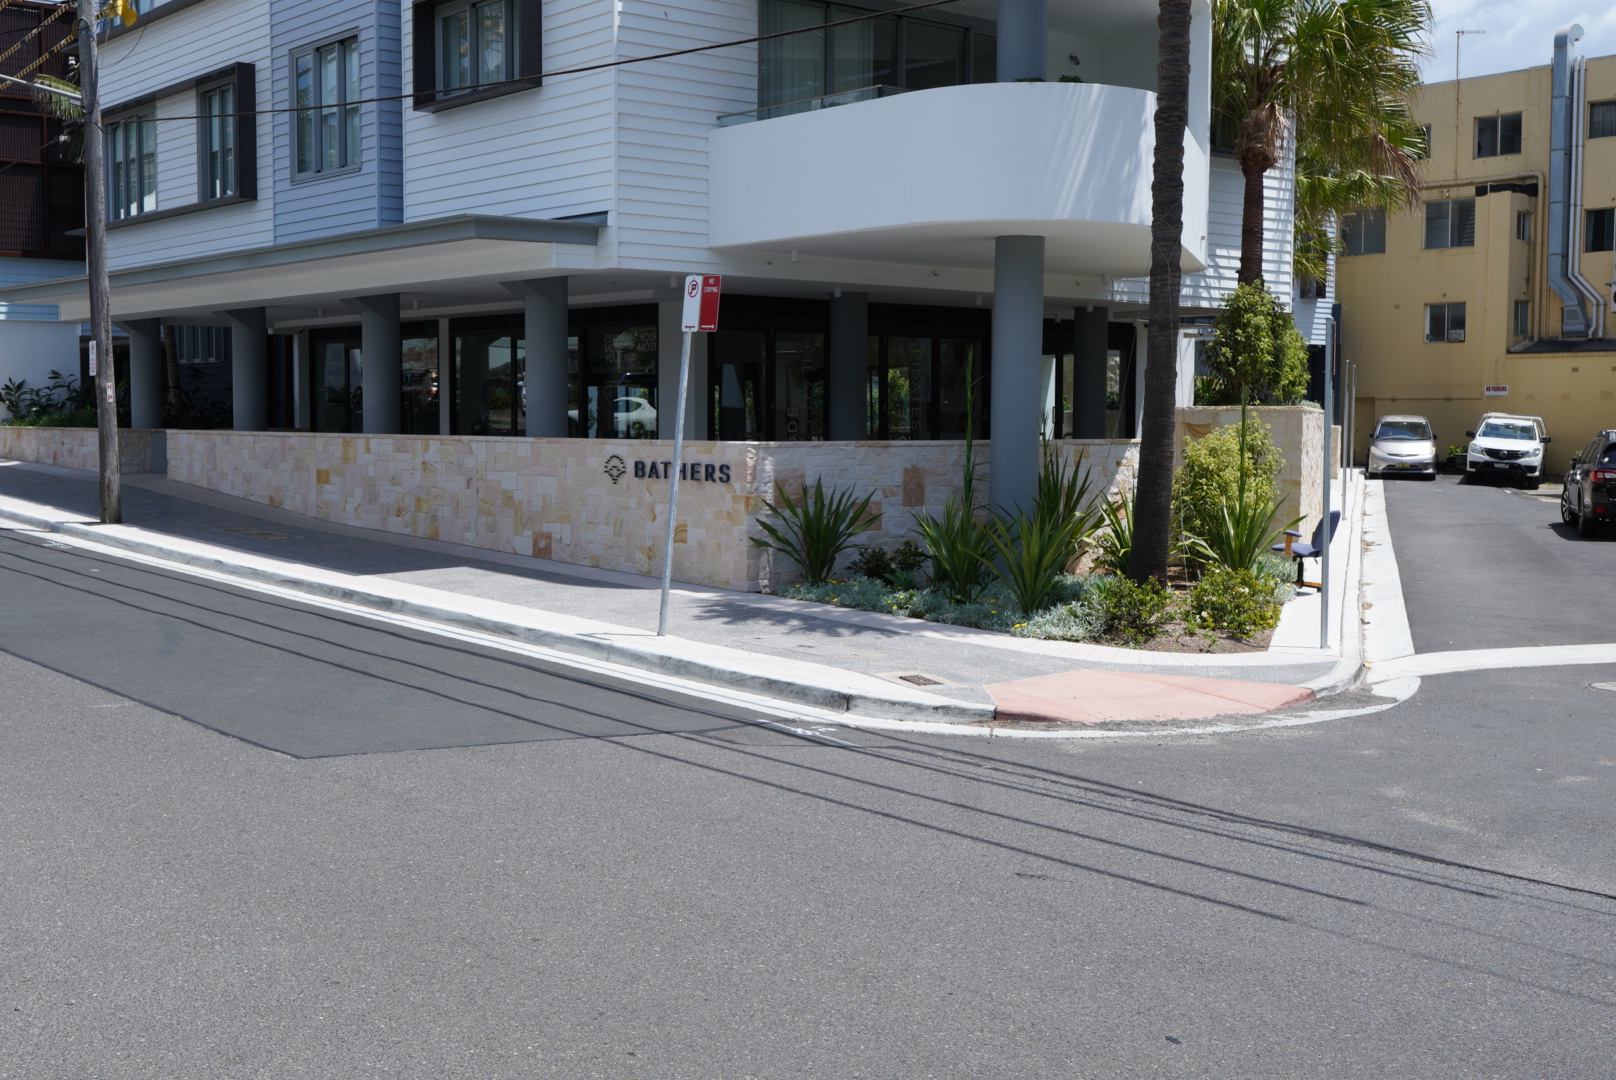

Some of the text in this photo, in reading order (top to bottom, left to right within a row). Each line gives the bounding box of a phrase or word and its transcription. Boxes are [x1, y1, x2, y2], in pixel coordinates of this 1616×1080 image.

[624, 352, 638, 362] WAY
[911, 349, 921, 430] PILATES
[634, 460, 731, 483] BATHERS
